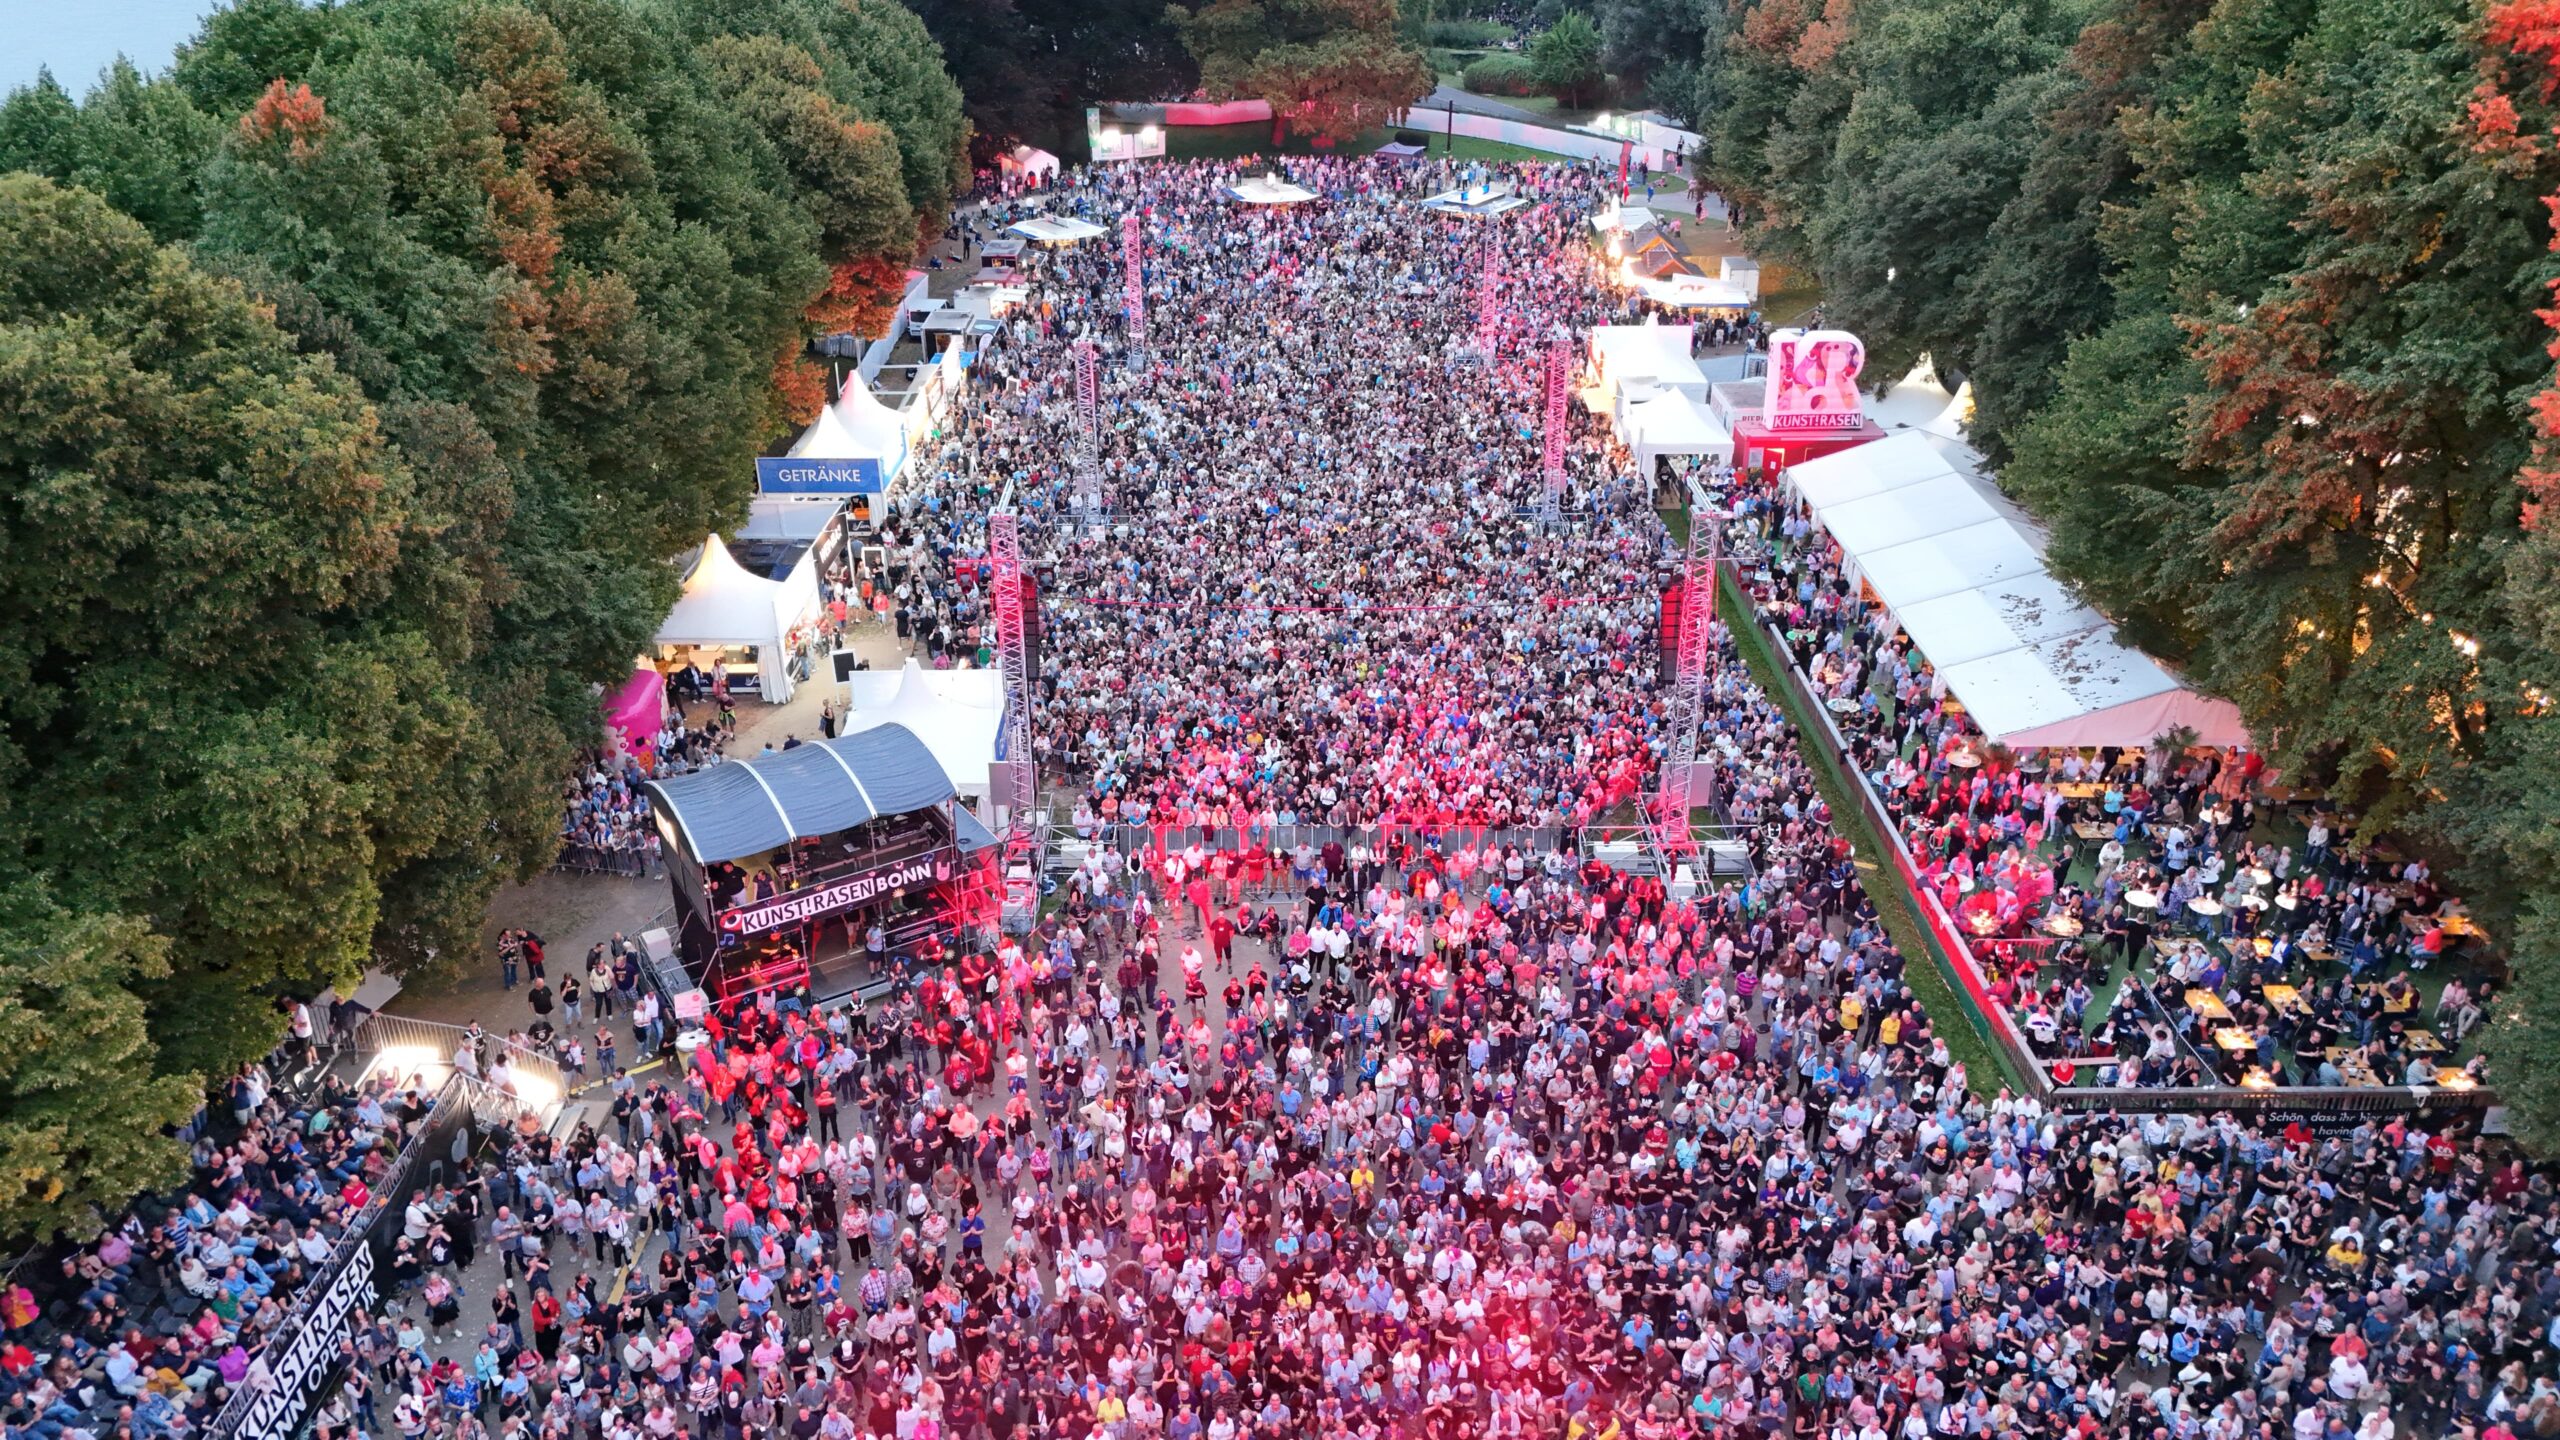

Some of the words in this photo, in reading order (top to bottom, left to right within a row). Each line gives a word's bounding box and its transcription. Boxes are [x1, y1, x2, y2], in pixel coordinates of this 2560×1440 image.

[1774, 414, 1860, 428] KUNST!RASEN
[778, 465, 861, 482] GETRÄNKE
[743, 879, 874, 932] KUNST!RASEN
[876, 863, 931, 893] BONN
[2310, 1111, 2337, 1122] dass
[307, 1317, 352, 1392] OPEN
